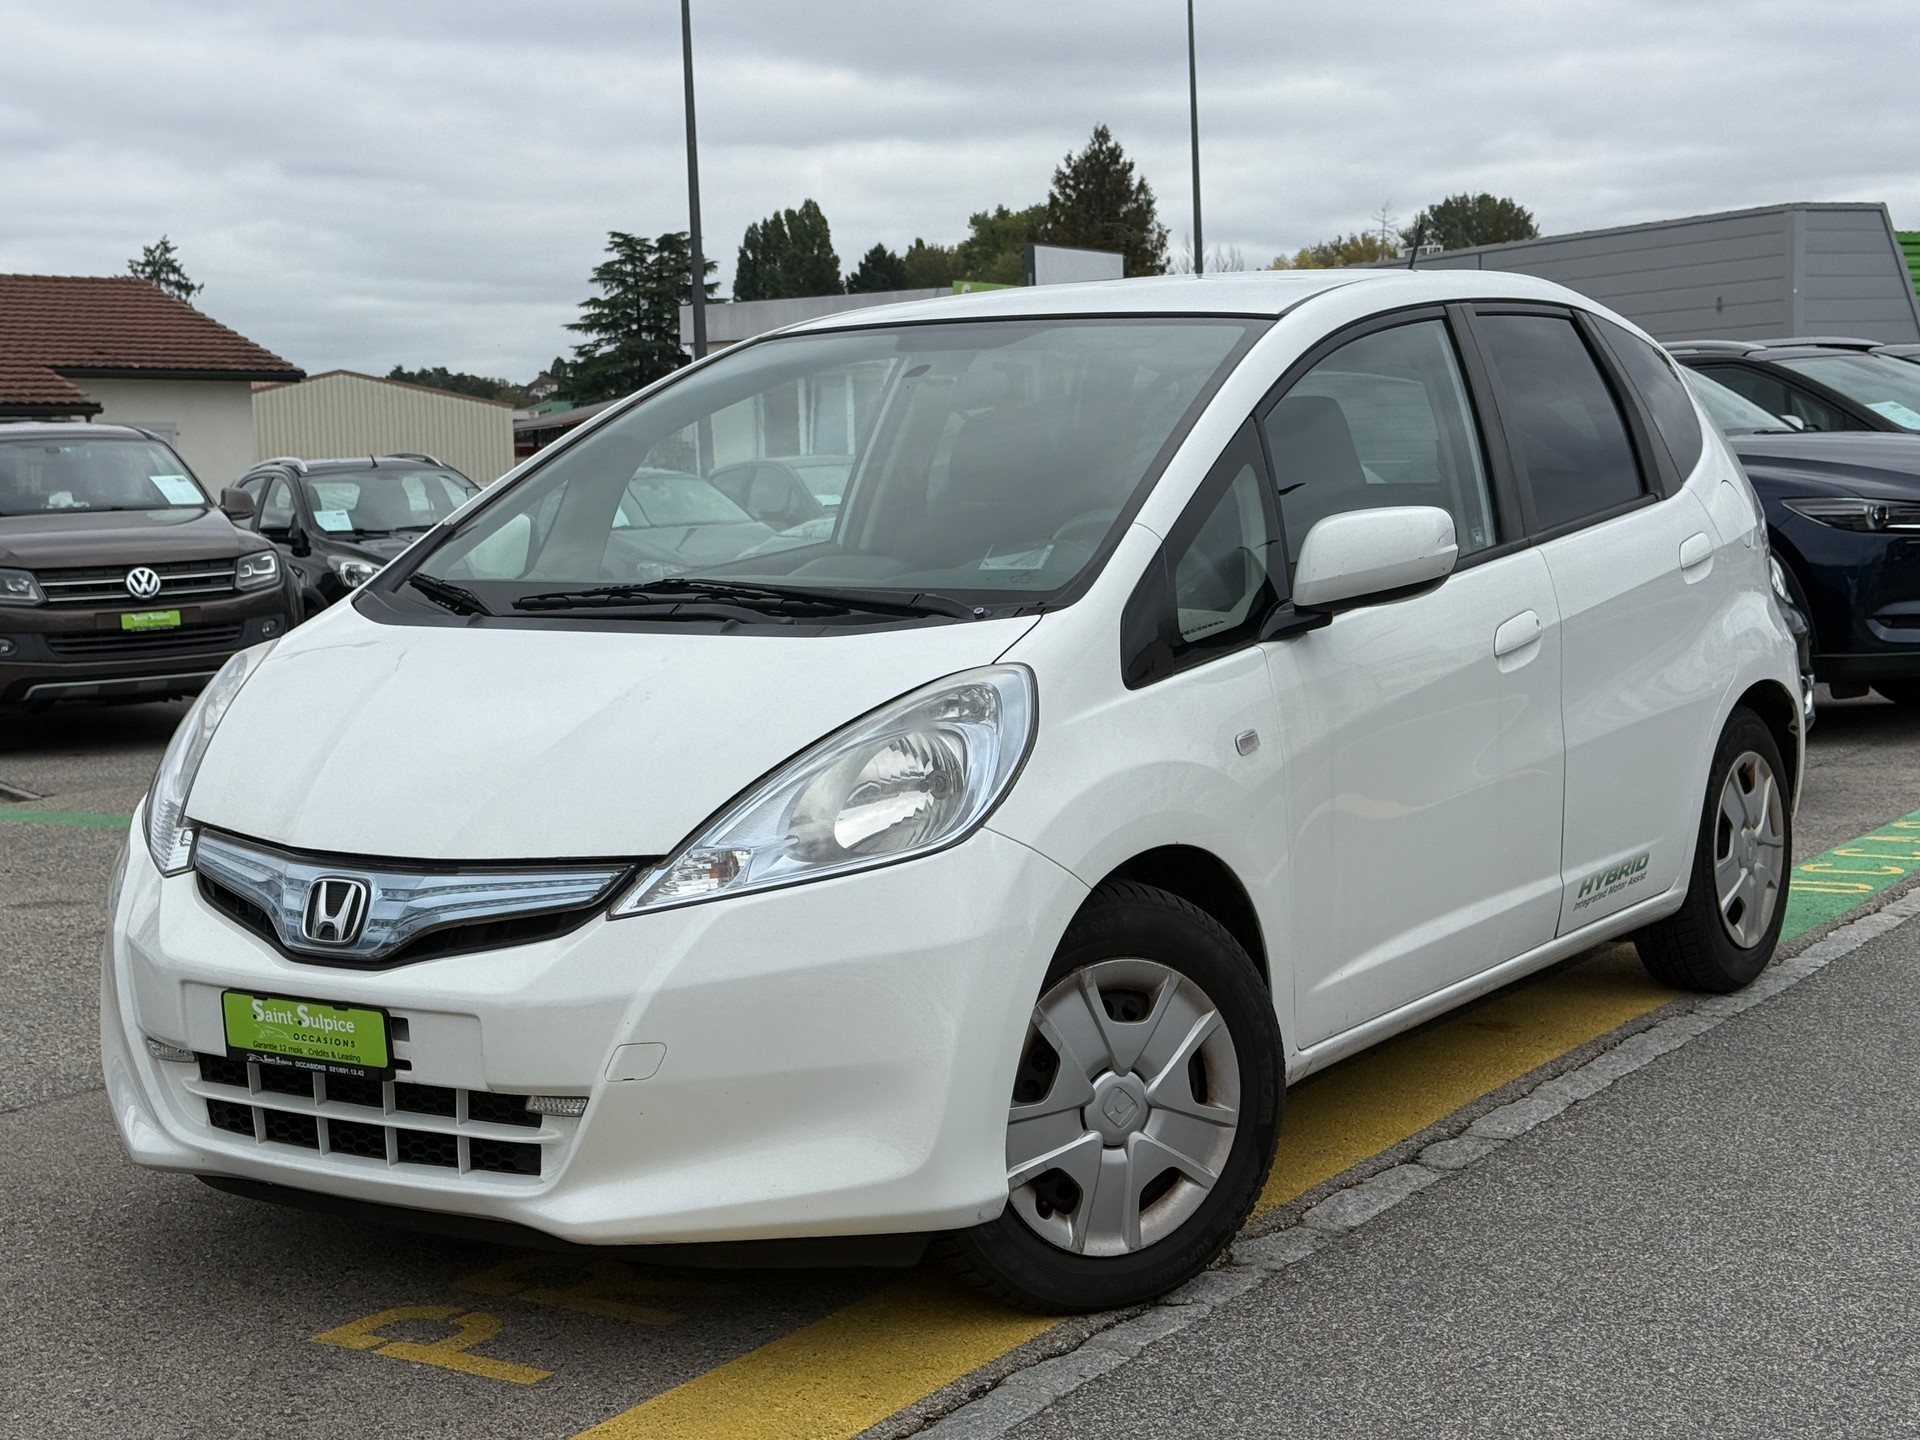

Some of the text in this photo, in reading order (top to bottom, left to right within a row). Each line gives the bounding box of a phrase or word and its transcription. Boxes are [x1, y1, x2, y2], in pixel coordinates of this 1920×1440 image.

[1578, 852, 1649, 898] HYBRID
[293, 1033, 355, 1048] OCCASIONS
[253, 1041, 277, 1050] Garantie
[279, 1044, 287, 1052] 12
[289, 1046, 303, 1054] mois
[338, 1052, 361, 1063] Leasing
[295, 1061, 326, 1071] OCCASIONS
